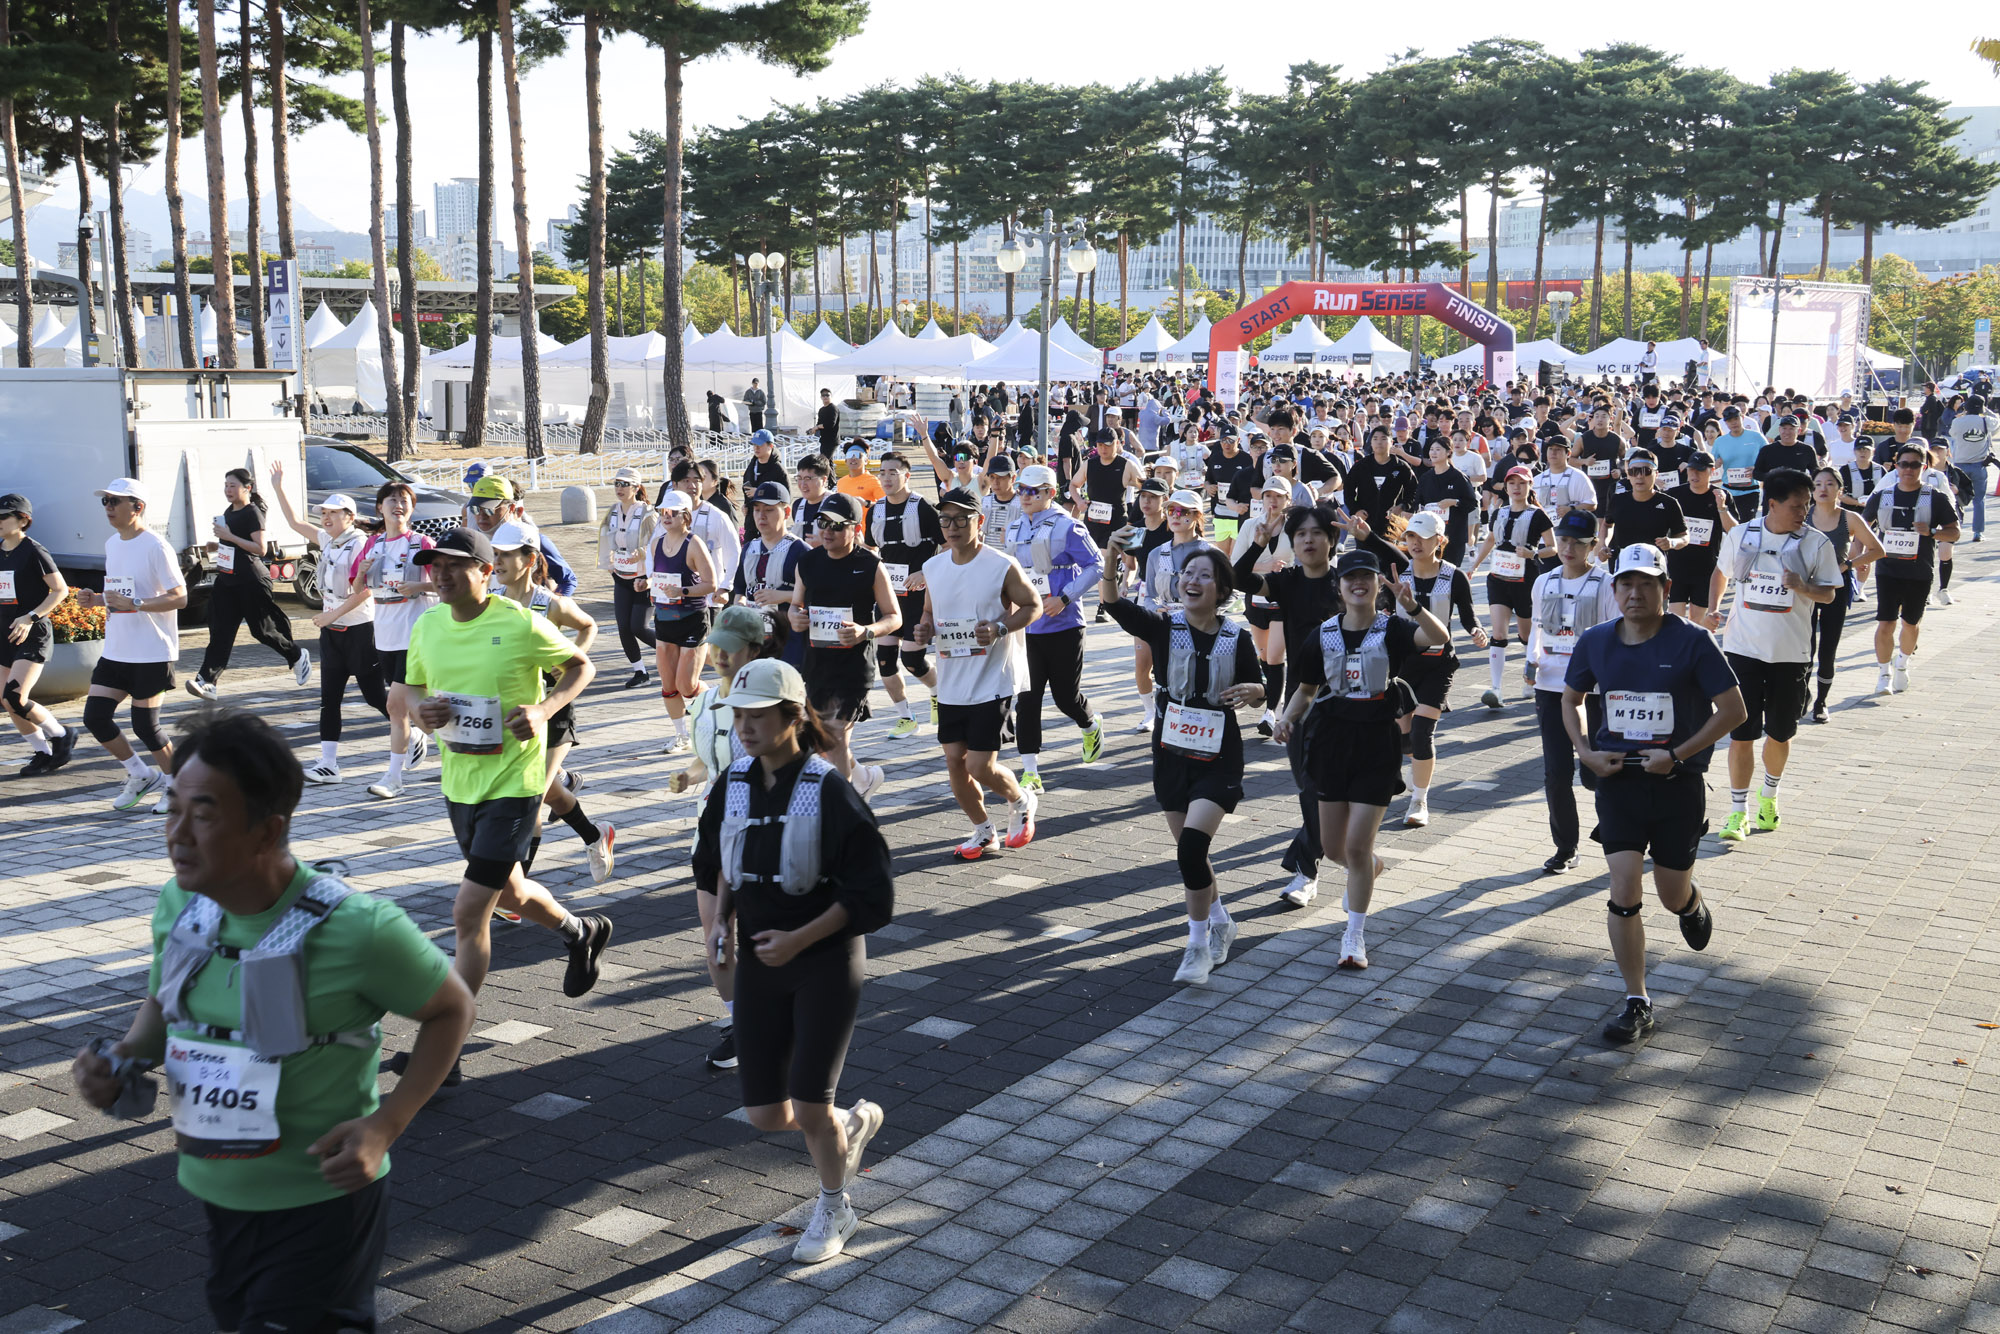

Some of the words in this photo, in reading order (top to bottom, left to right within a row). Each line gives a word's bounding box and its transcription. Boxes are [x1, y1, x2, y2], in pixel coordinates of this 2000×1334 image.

[274, 266, 283, 288] E
[1314, 290, 1358, 310] Run
[1240, 296, 1292, 334] START
[1446, 296, 1498, 335] FINISH
[1454, 365, 1485, 373] PRESS
[1597, 364, 1616, 373] MC
[1622, 364, 1642, 373] 대기
[1032, 578, 1043, 586] 96
[1760, 584, 1788, 595] 1515
[950, 631, 976, 640] 1814
[734, 671, 749, 688] H
[1346, 670, 1360, 680] 20
[1168, 706, 1179, 714] Run
[1615, 709, 1625, 717] M
[1629, 709, 1664, 720] 1511
[454, 714, 493, 729] 1266
[1170, 722, 1178, 730] W
[1179, 724, 1215, 738] 2011
[191, 1084, 260, 1110] 1405
